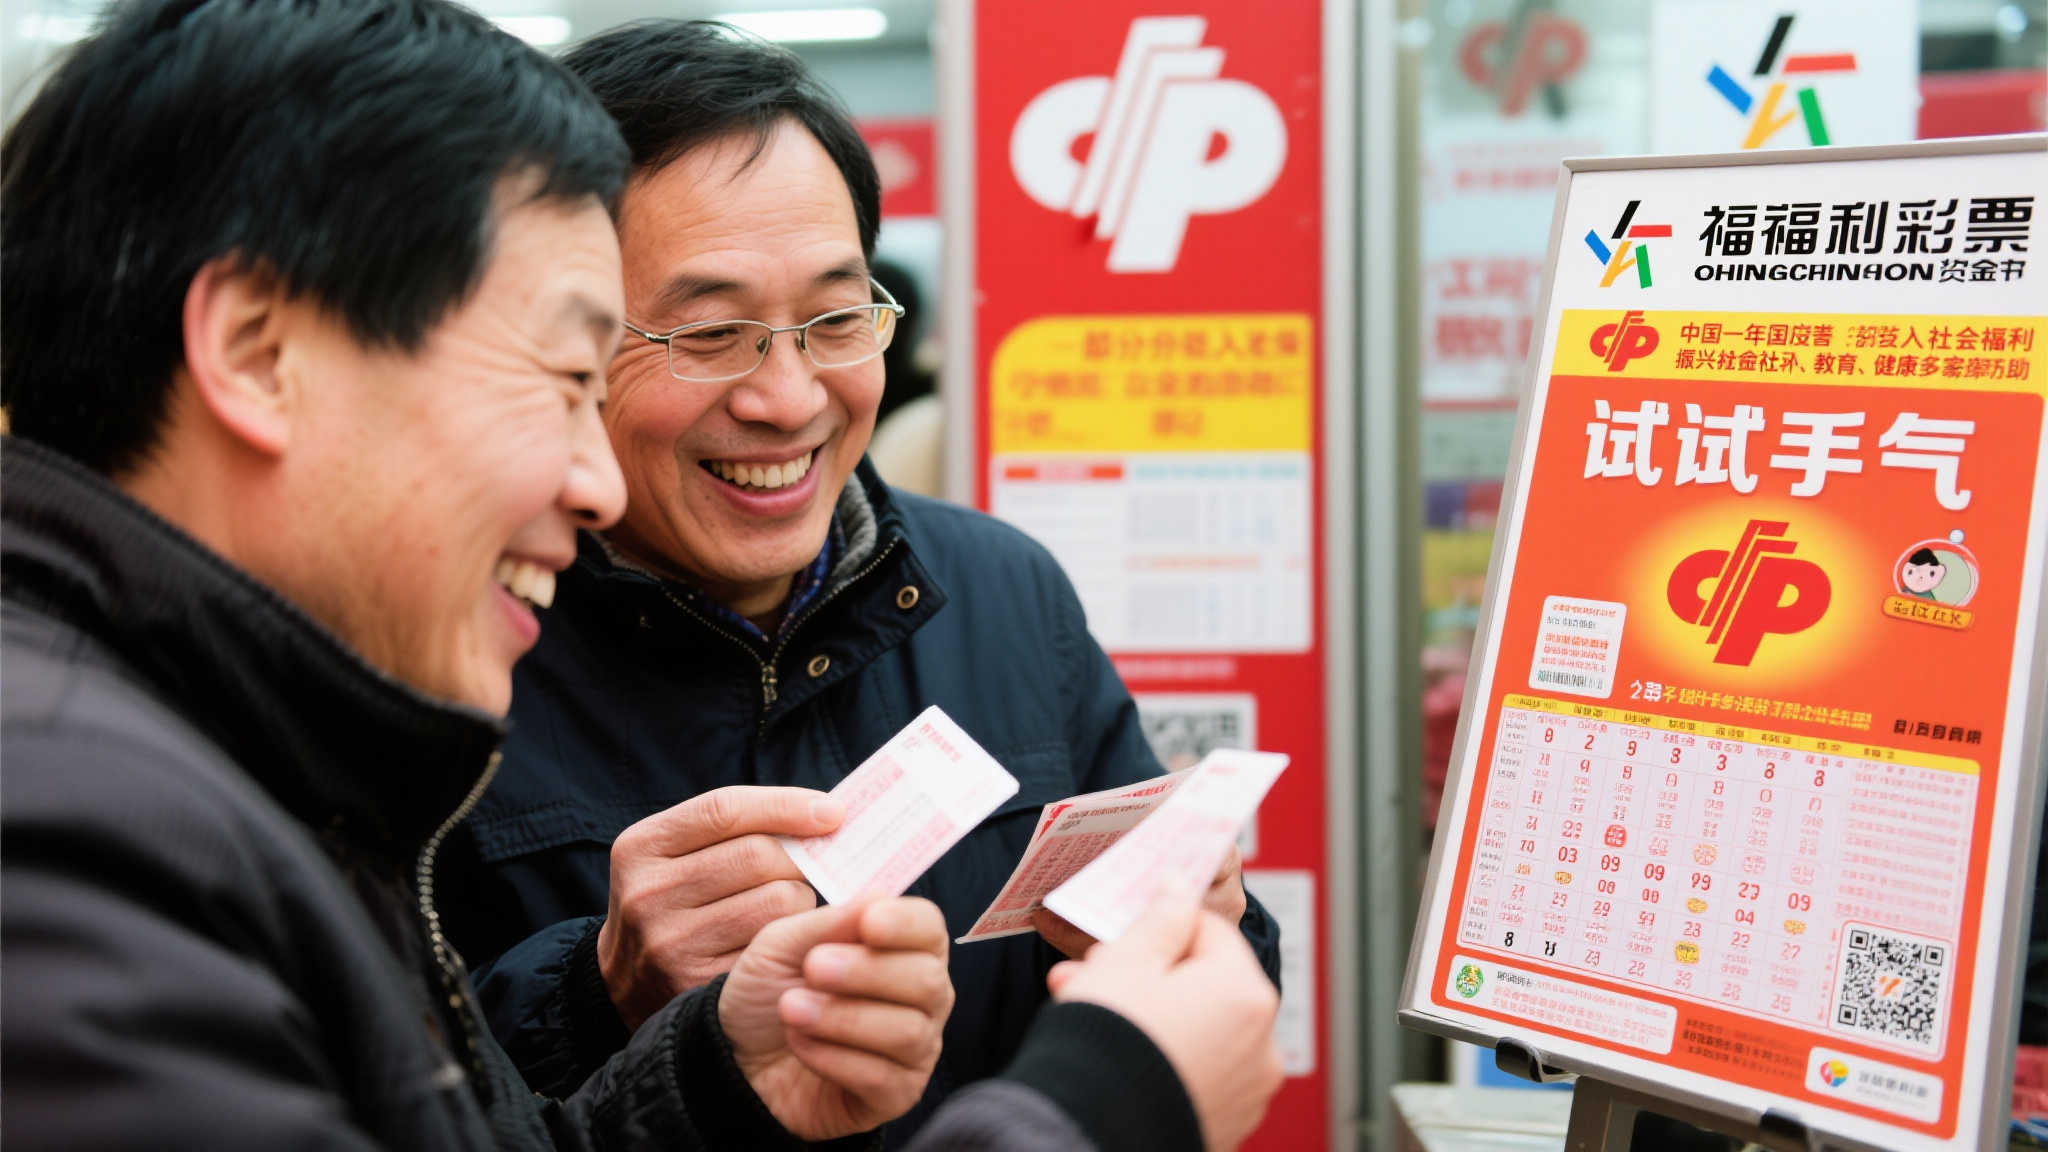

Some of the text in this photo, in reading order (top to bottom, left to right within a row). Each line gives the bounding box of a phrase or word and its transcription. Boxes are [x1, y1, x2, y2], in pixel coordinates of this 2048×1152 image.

[1699, 197, 2034, 257] 福福利彩票
[1583, 399, 1975, 511] 试试手气
[1584, 734, 1594, 750] 2
[1716, 753, 1728, 771] 3
[1558, 845, 1578, 863] 03
[1644, 863, 1665, 881] 09
[1788, 892, 1811, 912] 09
[1504, 931, 1514, 947] 8
[1735, 907, 1755, 925] 04
